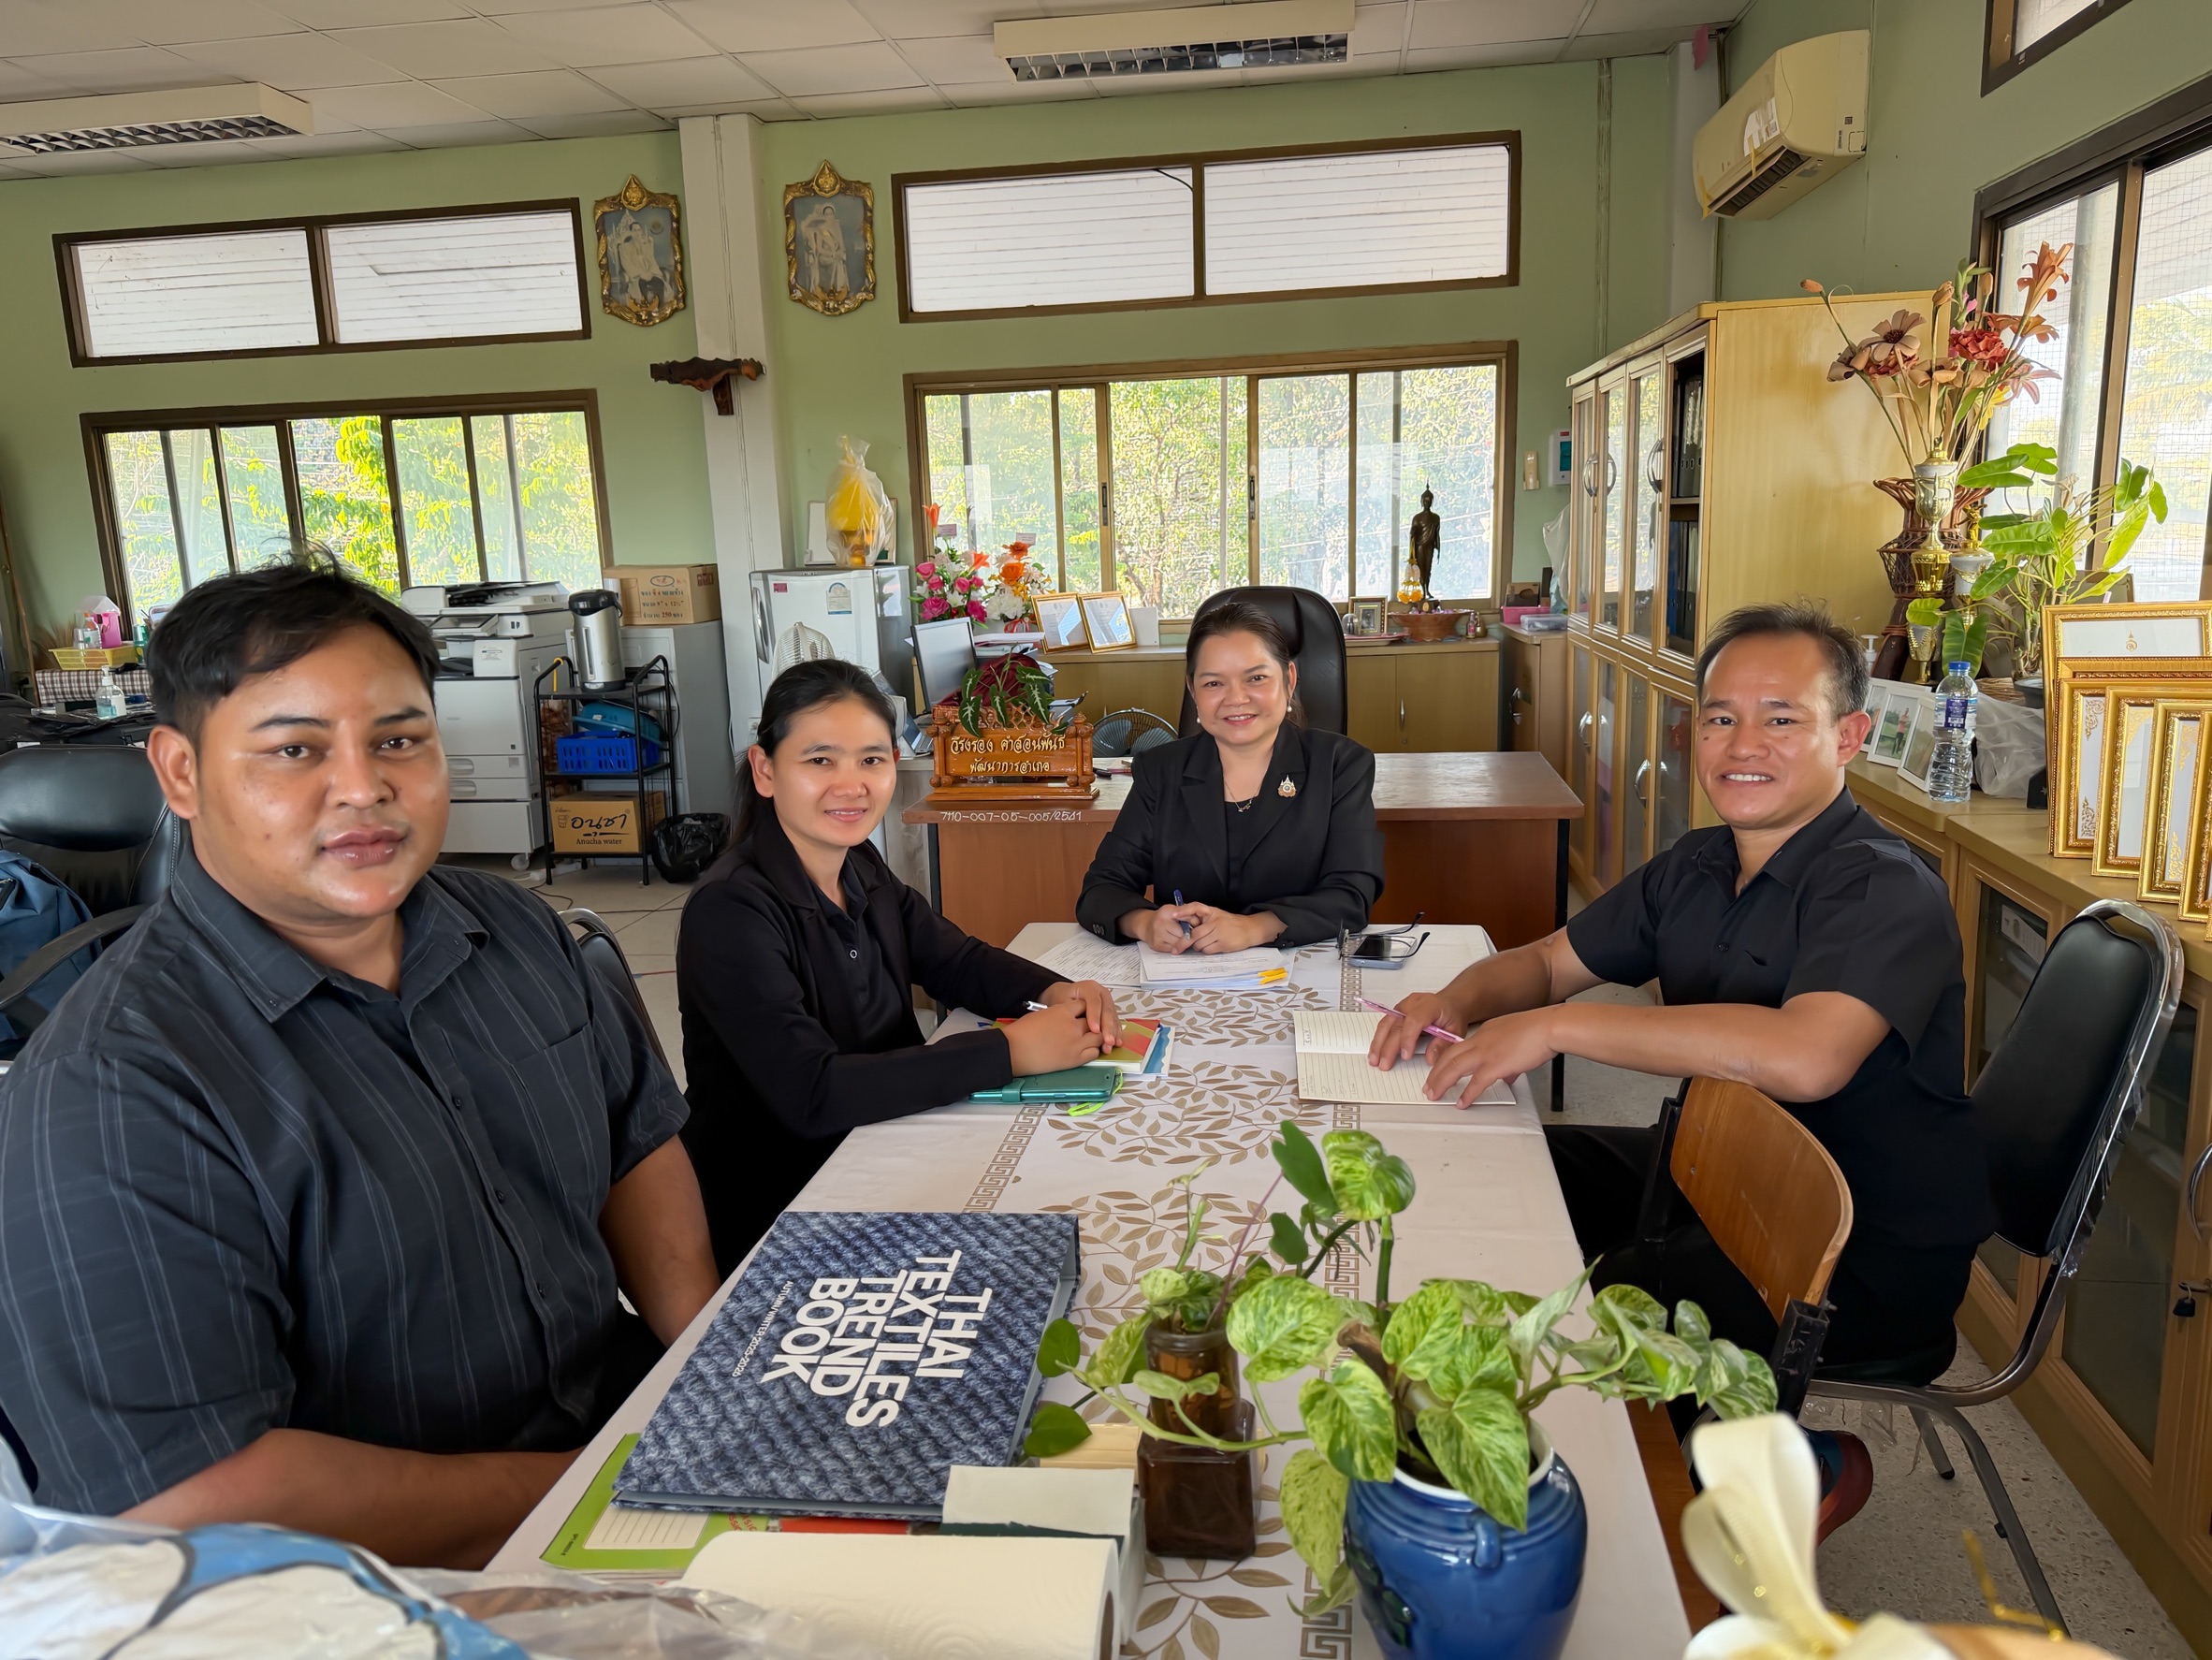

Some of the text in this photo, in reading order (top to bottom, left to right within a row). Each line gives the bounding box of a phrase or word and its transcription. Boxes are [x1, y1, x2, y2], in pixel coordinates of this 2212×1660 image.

[969, 757, 1050, 775] พัฒนาการอำเภอ
[732, 1280, 794, 1377] AUTUMN/WINTER 2025-2026
[761, 1276, 860, 1384] BOOK
[809, 1269, 909, 1397] TREND
[845, 1249, 962, 1428] TEXTILES
[914, 1287, 992, 1379] THAI
